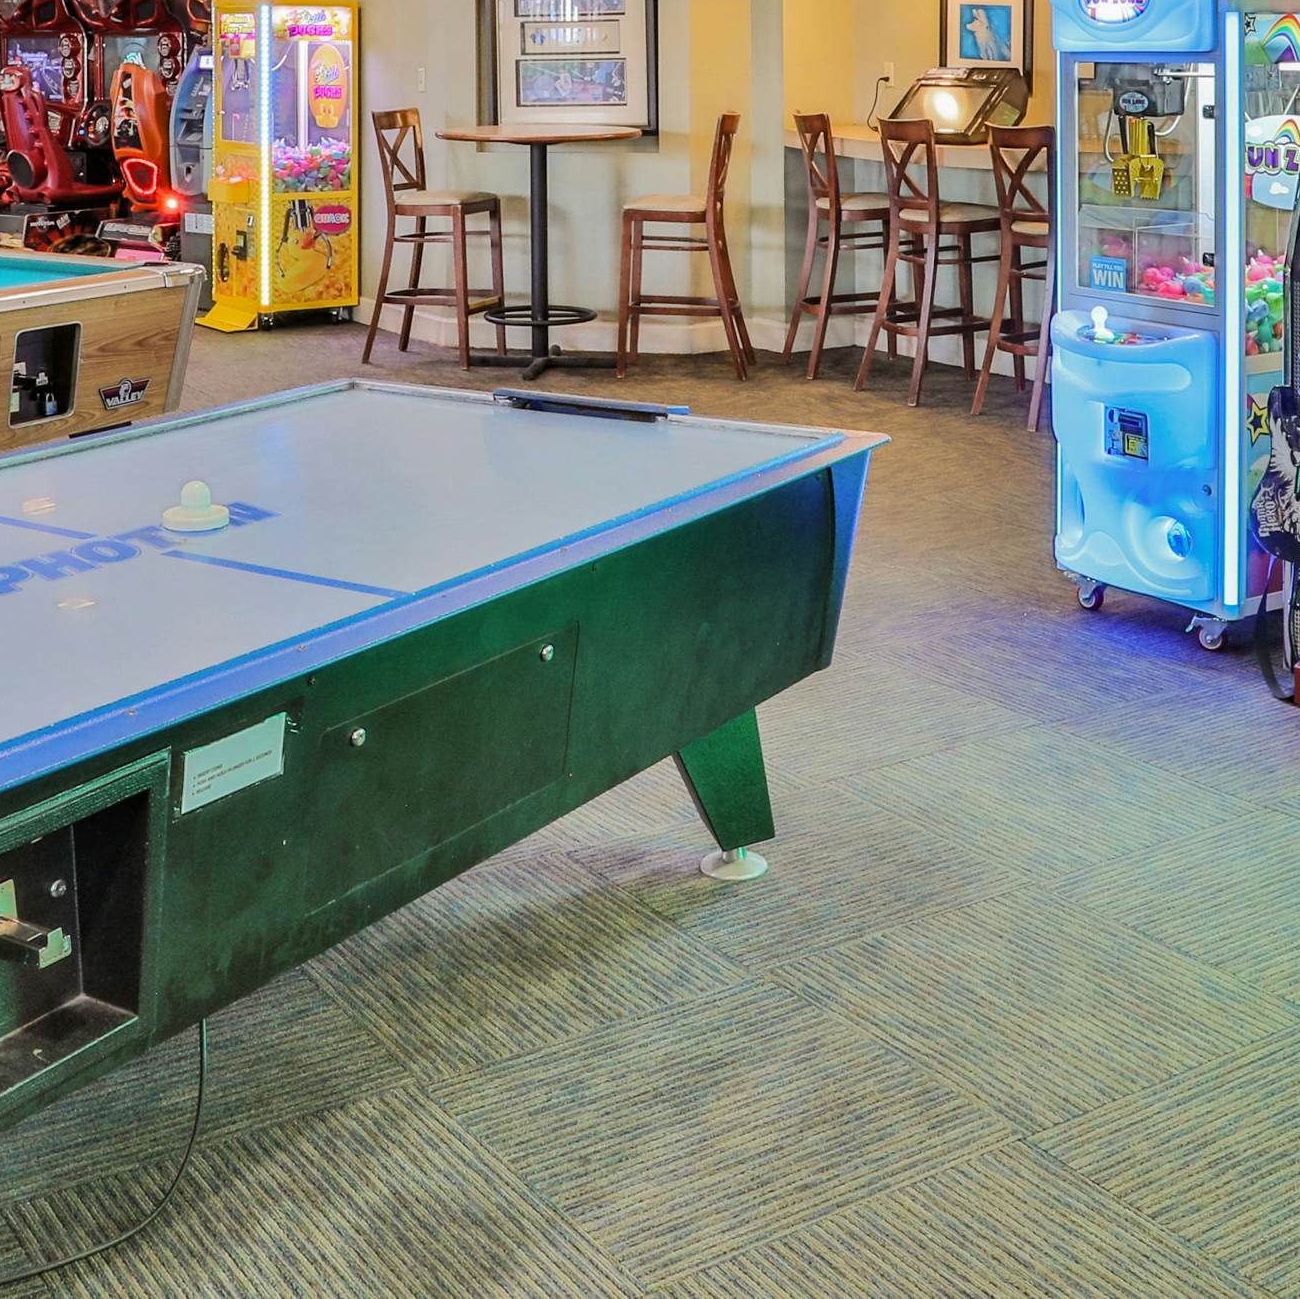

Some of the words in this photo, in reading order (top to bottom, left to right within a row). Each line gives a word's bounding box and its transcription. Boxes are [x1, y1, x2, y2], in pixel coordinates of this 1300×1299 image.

[1247, 145, 1279, 169] UN
[314, 213, 350, 224] QUACK
[1093, 269, 1124, 288] WIN
